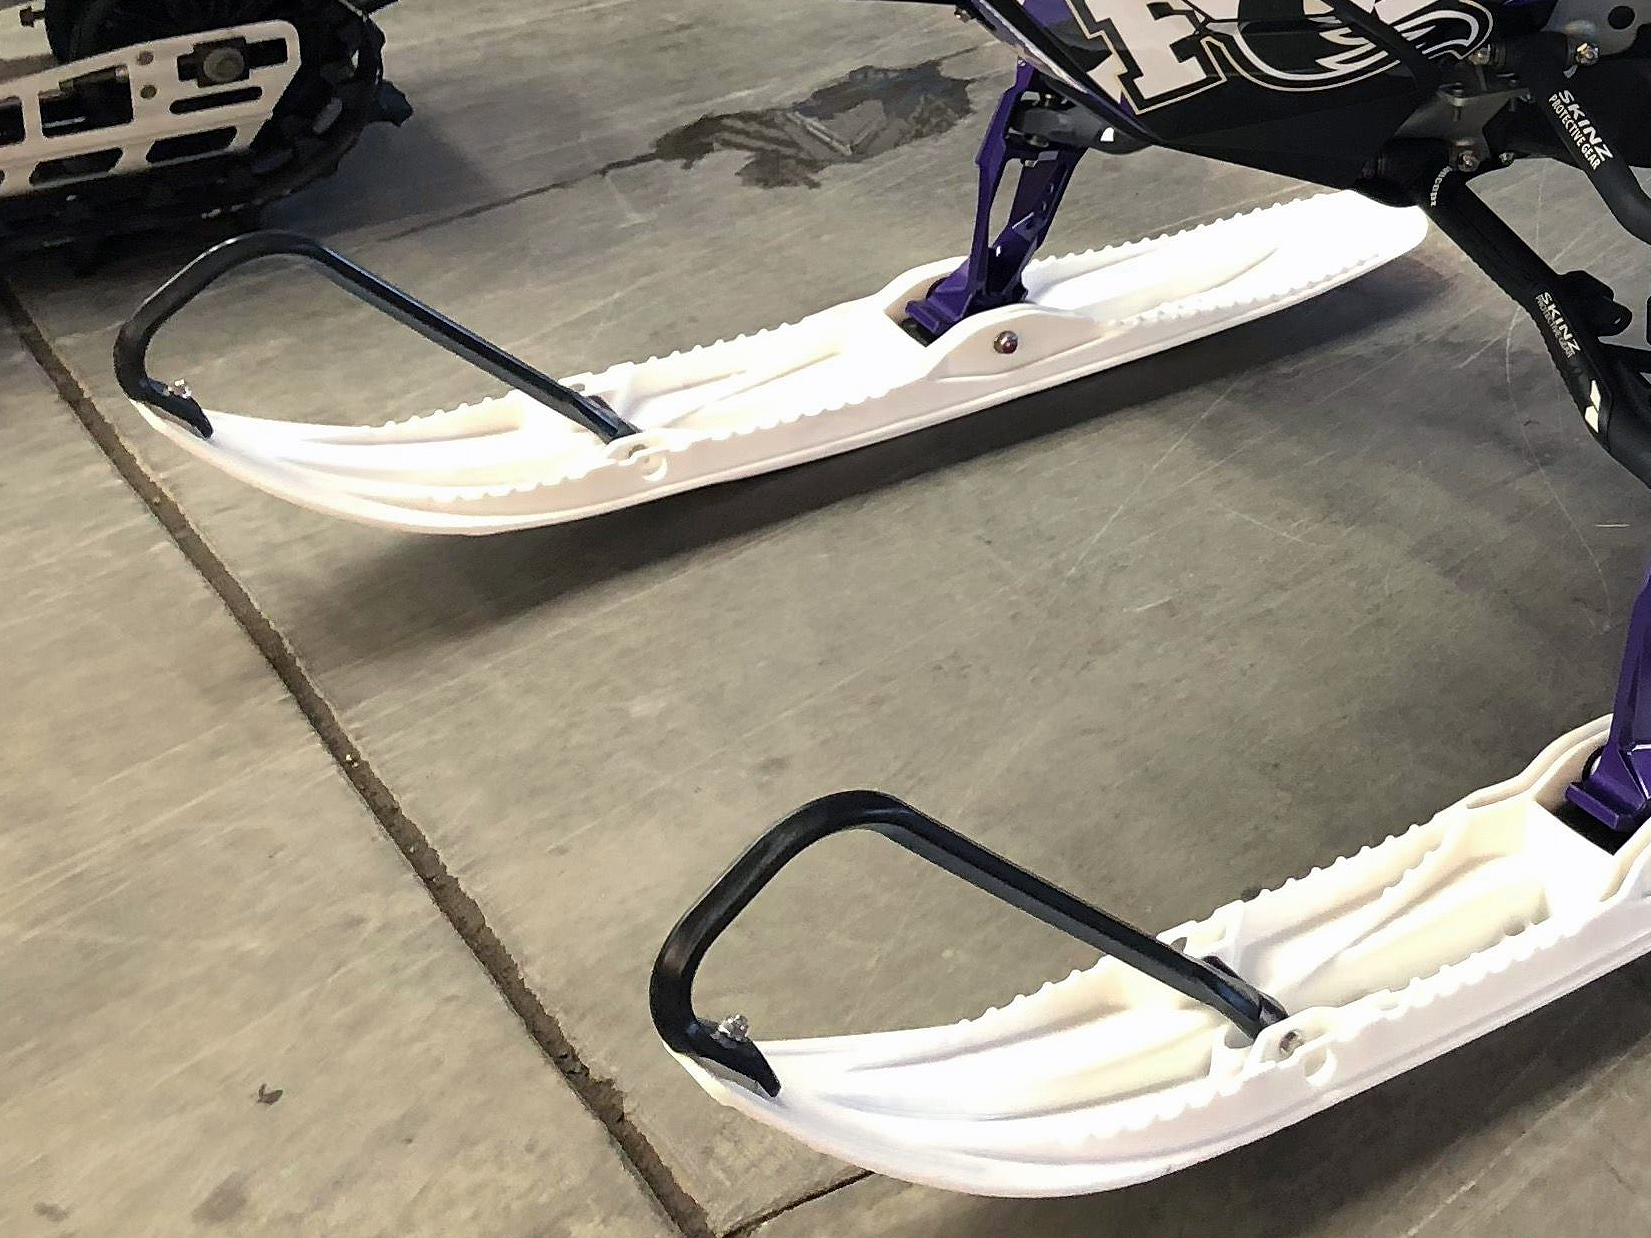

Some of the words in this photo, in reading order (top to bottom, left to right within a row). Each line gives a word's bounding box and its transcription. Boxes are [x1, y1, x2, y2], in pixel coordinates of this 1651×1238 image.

[1548, 93, 1586, 147] PROTECTIVE
[1581, 143, 1601, 170] GEAR
[1558, 89, 1614, 162] SKINZ
[1542, 291, 1582, 353] SKINZ
